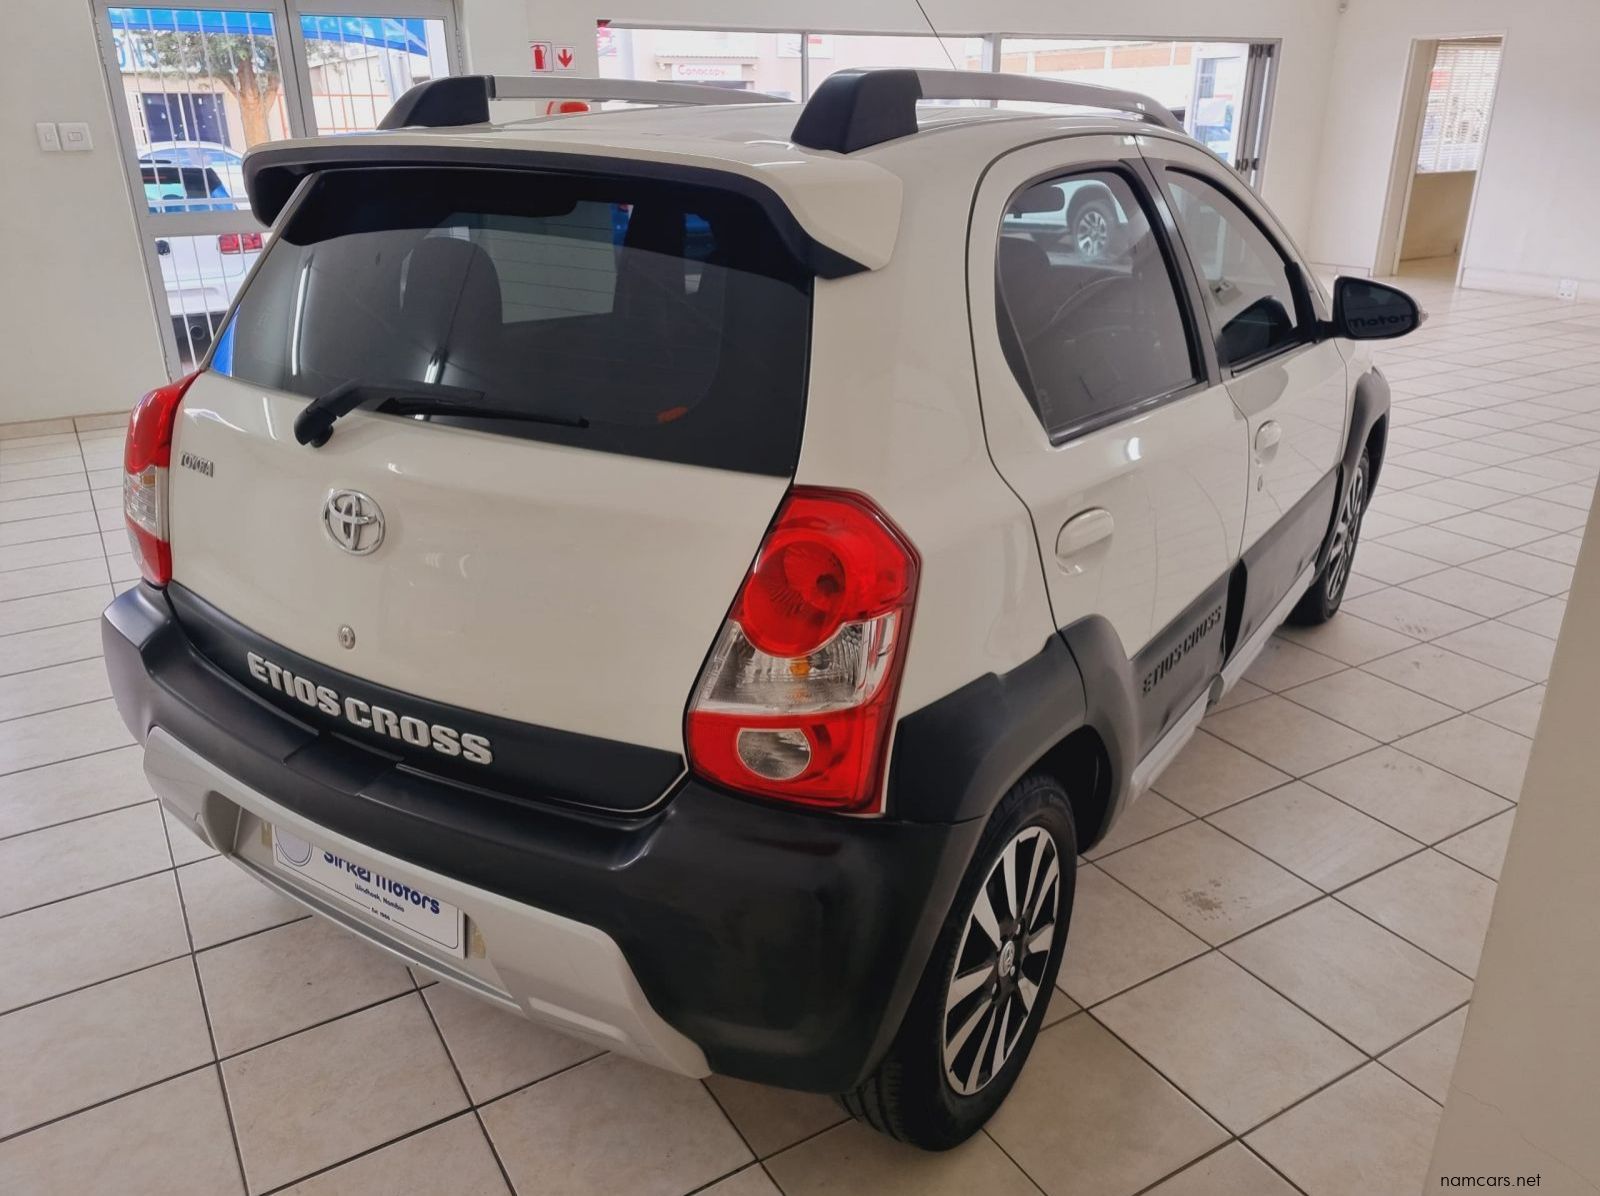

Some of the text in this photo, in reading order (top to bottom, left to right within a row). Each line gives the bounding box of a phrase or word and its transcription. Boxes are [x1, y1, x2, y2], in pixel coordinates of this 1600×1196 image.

[1142, 605, 1222, 694] ETIOS CROSS
[247, 651, 494, 766] ETIOS CROSS
